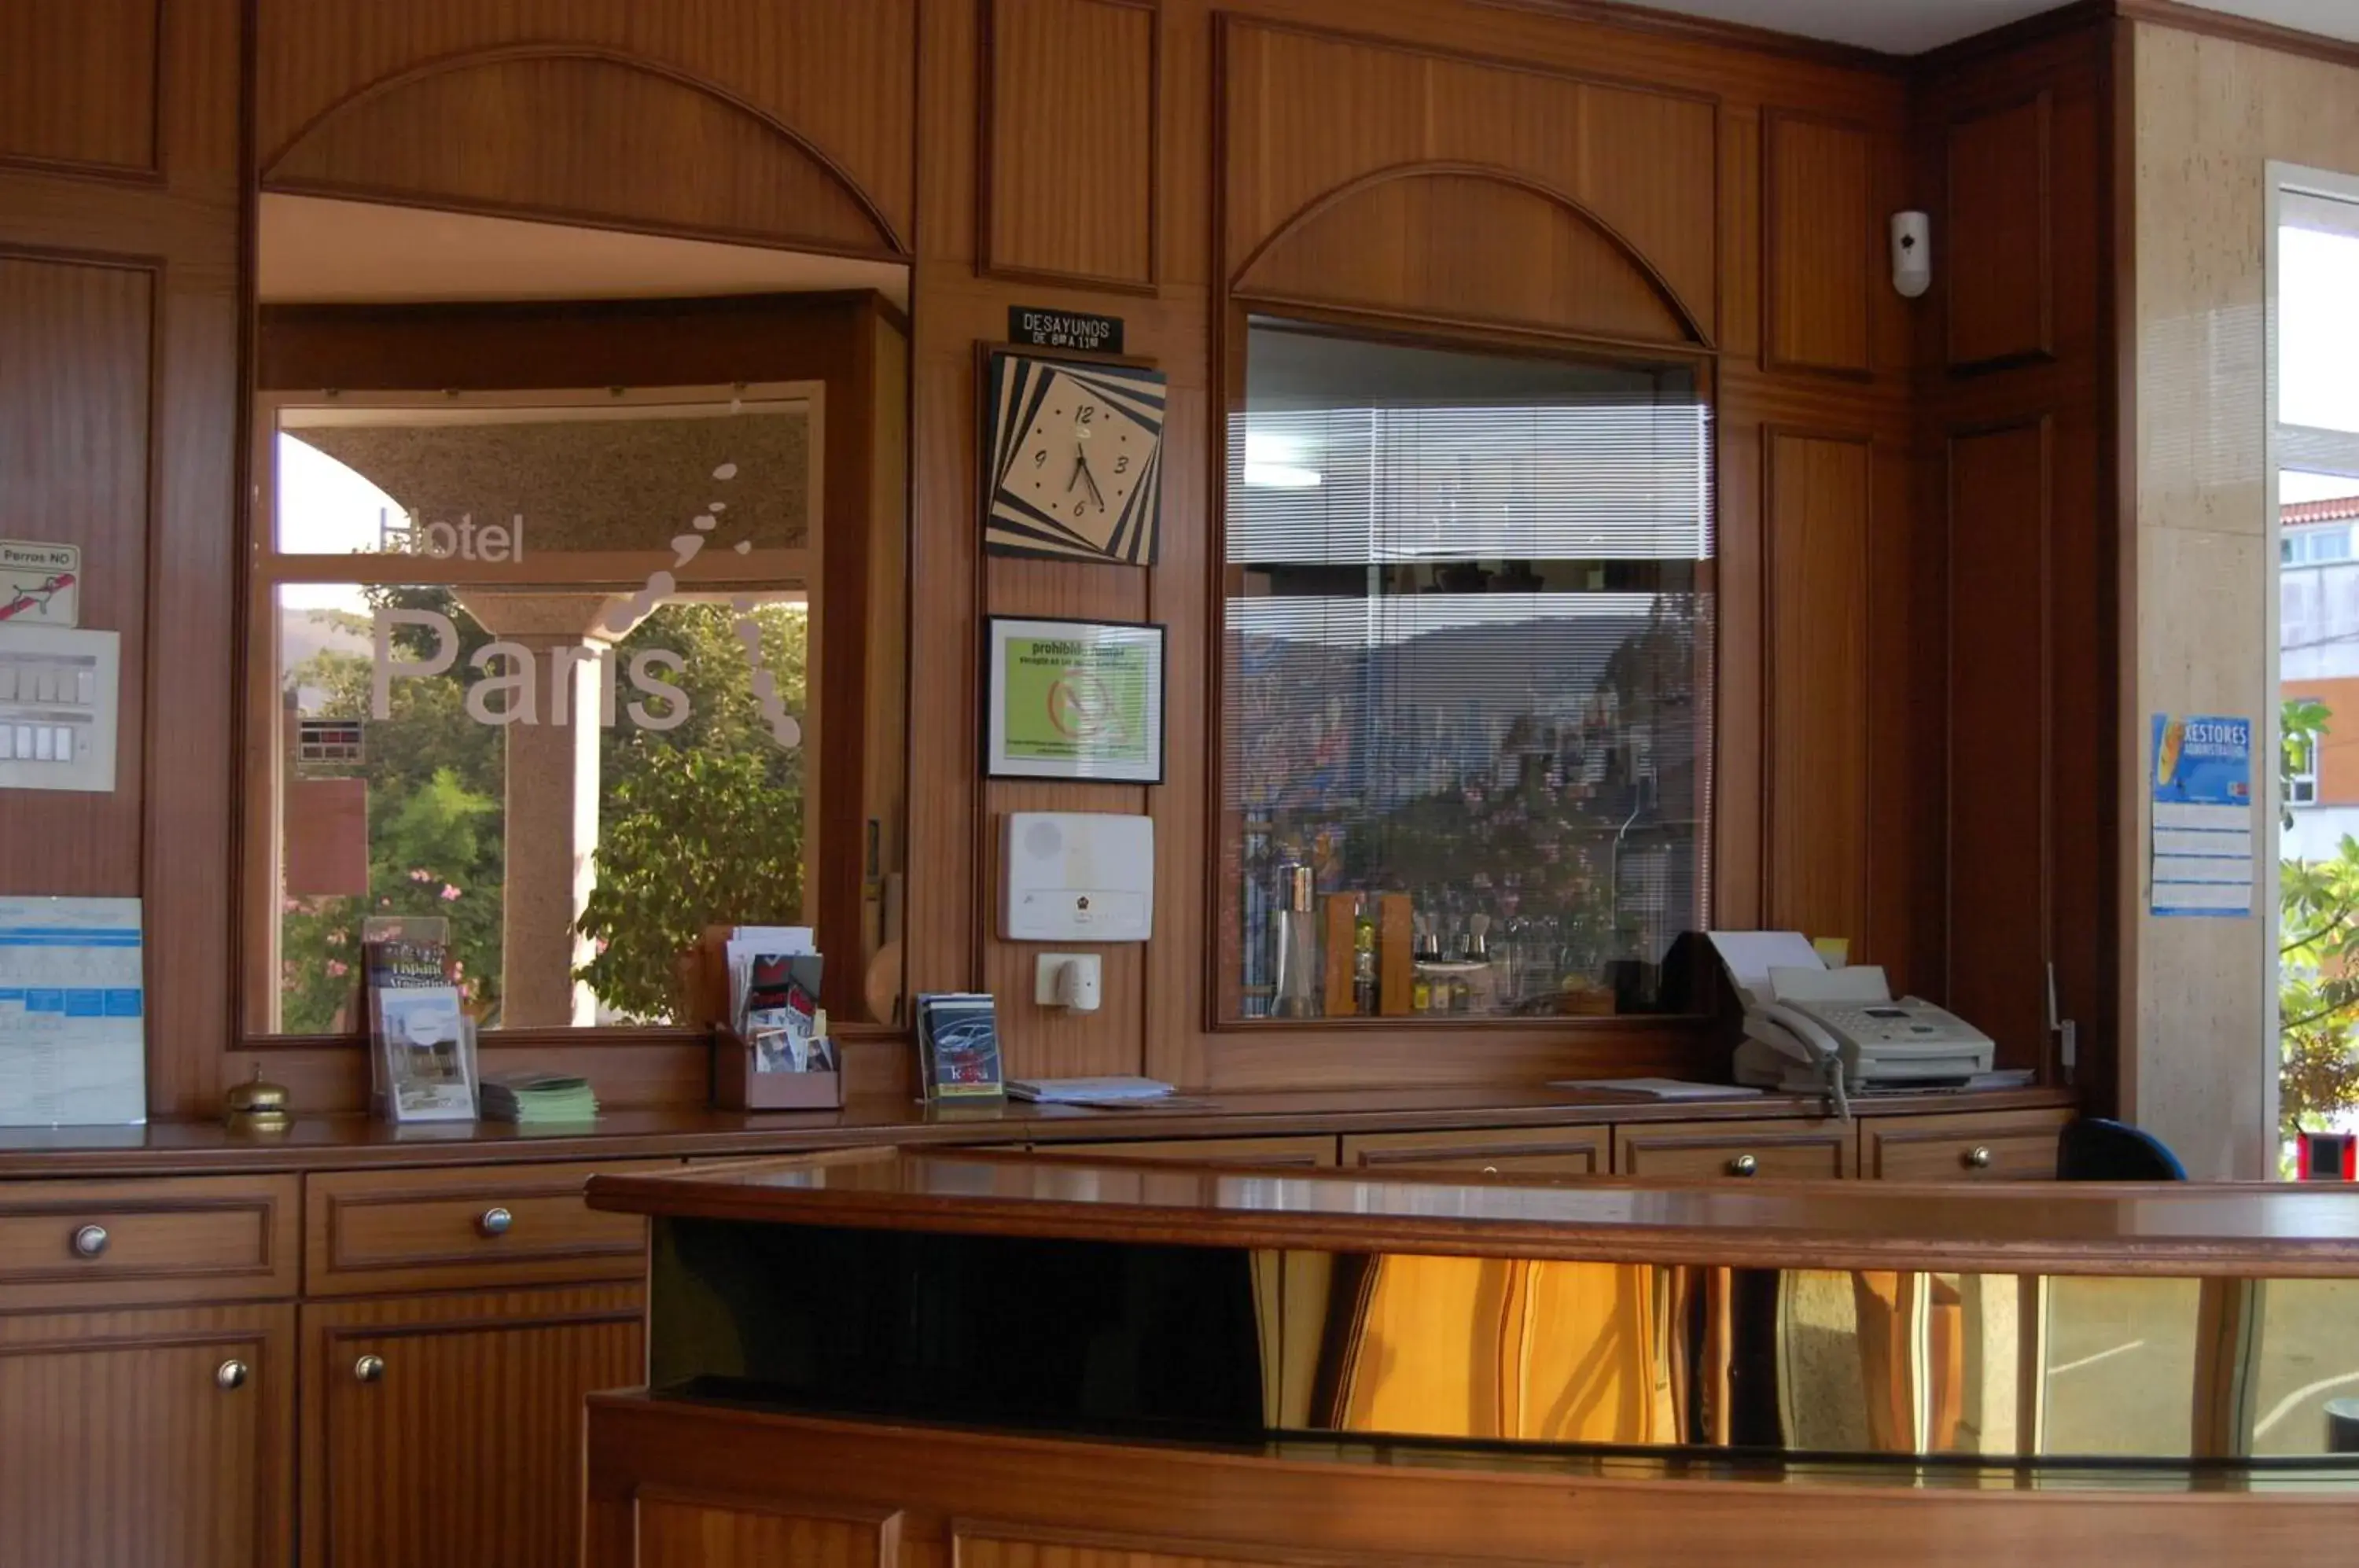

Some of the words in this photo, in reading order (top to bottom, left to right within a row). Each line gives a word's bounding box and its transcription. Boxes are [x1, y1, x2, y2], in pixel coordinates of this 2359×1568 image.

[1024, 314, 1110, 338] DESAYUNOS
[1032, 331, 1046, 344] DE
[1068, 336, 1075, 347] A
[1074, 405, 1095, 424] 12
[1035, 450, 1047, 469] 9
[1113, 455, 1129, 474] 3
[1073, 500, 1086, 517] 6
[381, 507, 523, 563] Hotel
[4, 549, 45, 563] Perros
[50, 553, 70, 565] NO
[1032, 641, 1090, 657] prohibid
[371, 609, 690, 730] Paris
